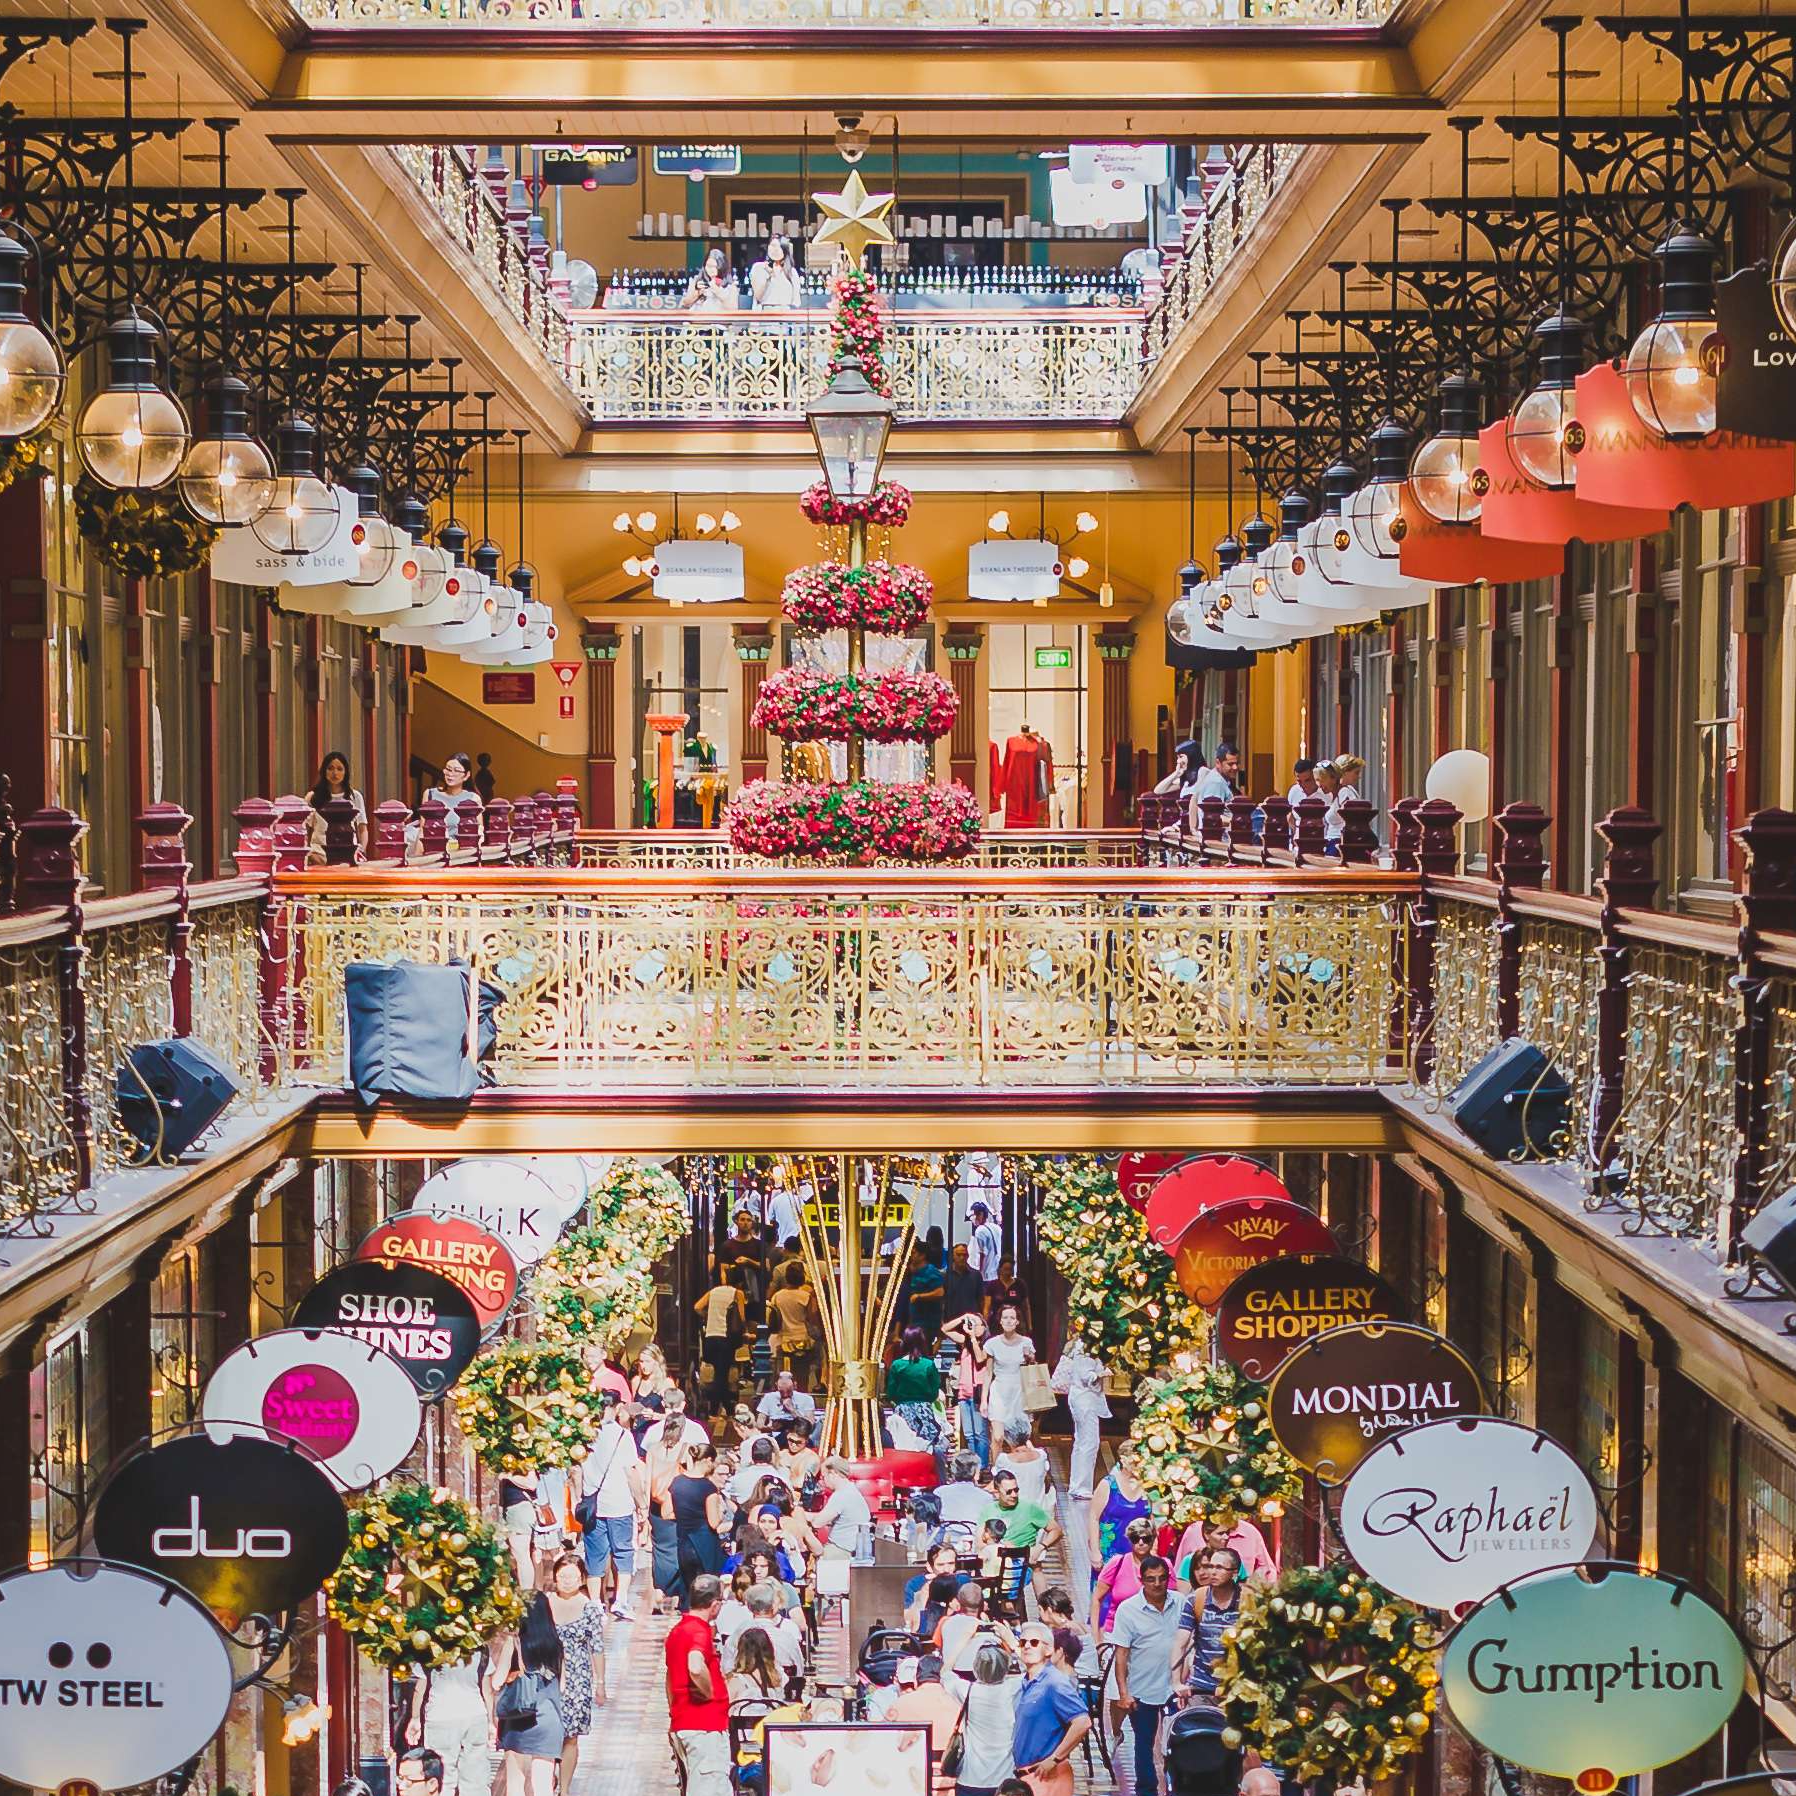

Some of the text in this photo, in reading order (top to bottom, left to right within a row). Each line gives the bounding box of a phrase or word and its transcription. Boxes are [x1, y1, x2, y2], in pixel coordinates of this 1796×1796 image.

[1706, 345, 1726, 364] 61
[1564, 428, 1585, 446] 63
[1472, 477, 1490, 491] 65
[255, 555, 346, 568] sass & bide
[381, 1235, 499, 1267] GALLERY
[1183, 1247, 1257, 1271] VICTORIA
[338, 1293, 437, 1326] SHOE
[1245, 1287, 1377, 1313] GALLERY
[266, 1391, 351, 1420] Sweet
[1291, 1381, 1460, 1416] MONDIAL
[152, 1495, 292, 1558] duo
[1362, 1485, 1574, 1563] Raphaël
[1472, 1537, 1572, 1554] JEWELLERS
[1467, 1637, 1724, 1704] Gumption
[57, 1680, 164, 1708] STEEL
[1588, 1772, 1604, 1789] 11
